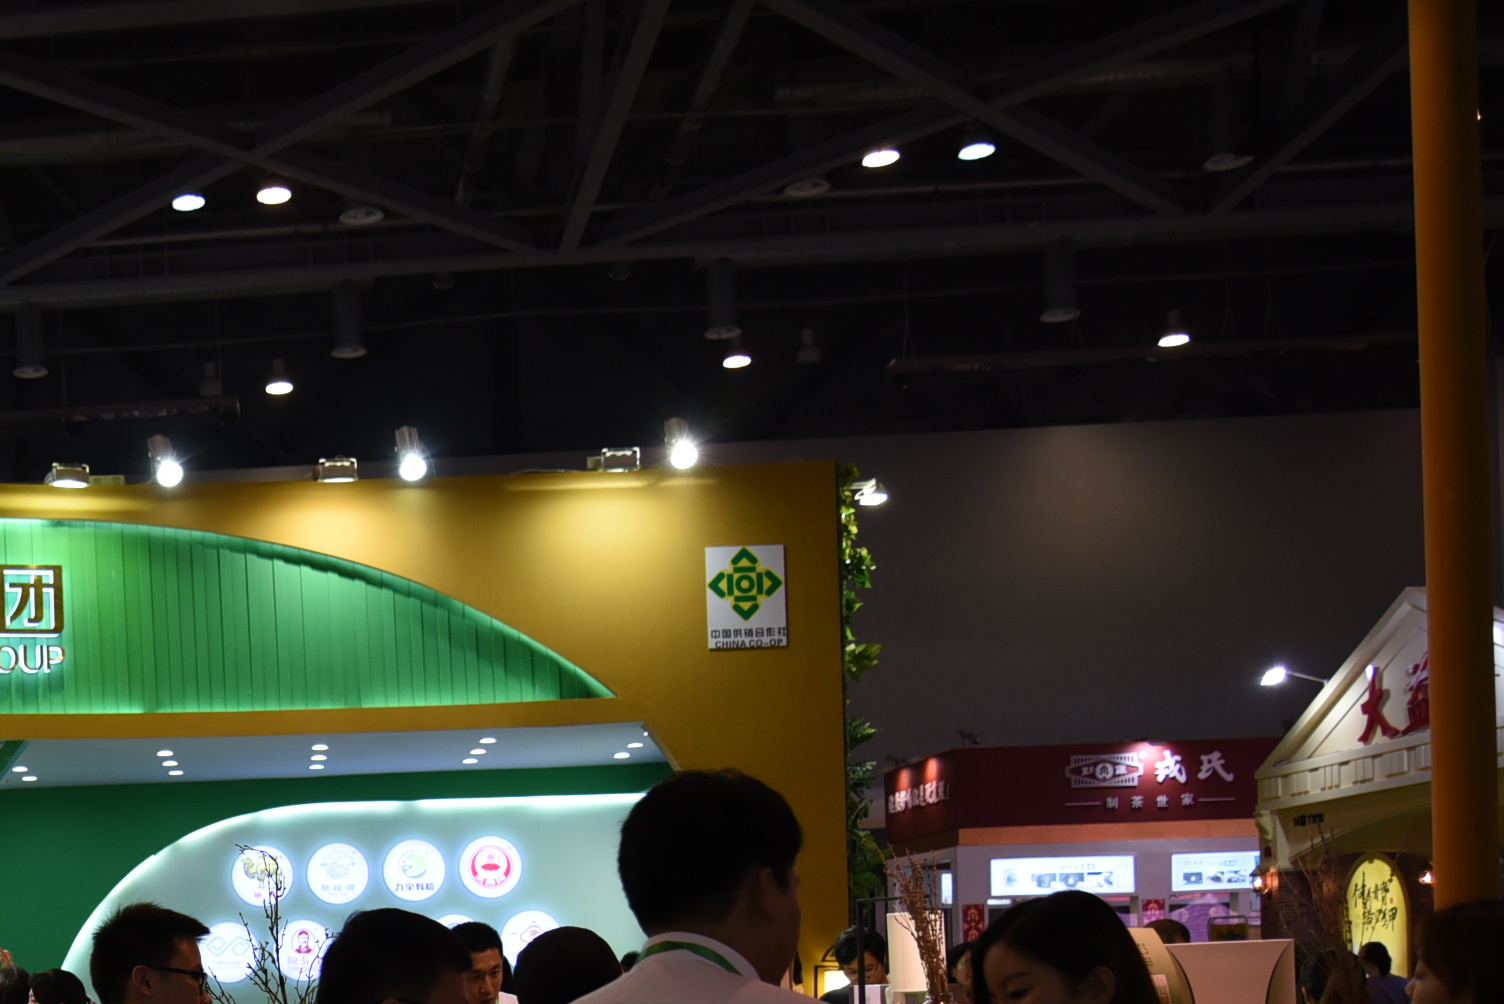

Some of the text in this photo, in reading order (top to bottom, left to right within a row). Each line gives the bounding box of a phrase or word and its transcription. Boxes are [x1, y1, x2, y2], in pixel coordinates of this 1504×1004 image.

[711, 627, 787, 639] 中国供销合作社
[715, 640, 747, 649] CHINA
